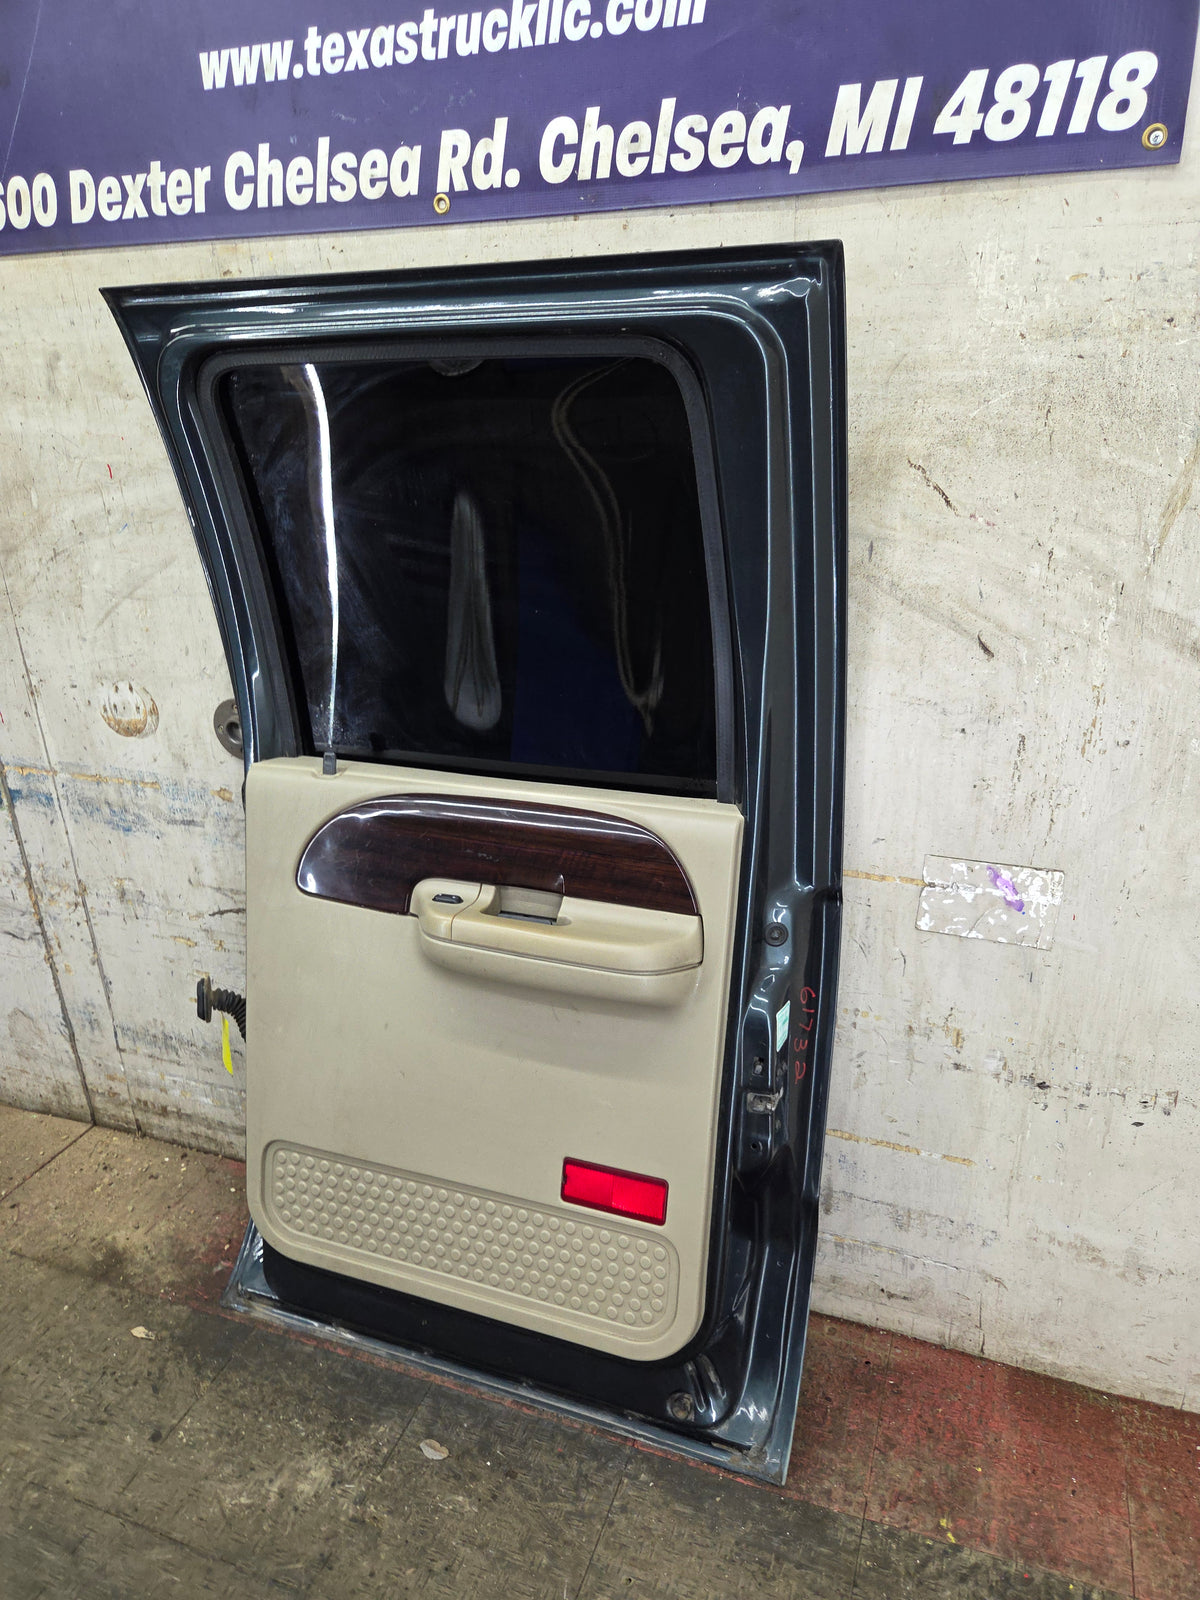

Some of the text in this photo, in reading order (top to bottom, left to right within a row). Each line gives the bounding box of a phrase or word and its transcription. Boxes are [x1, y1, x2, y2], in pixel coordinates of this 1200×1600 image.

[198, 0, 707, 91] www.texastruckllc.com
[0, 50, 1159, 231] 00 Dexter Chelsea Rd. Chelsea, MI 48118
[794, 986, 816, 1085] 61732
